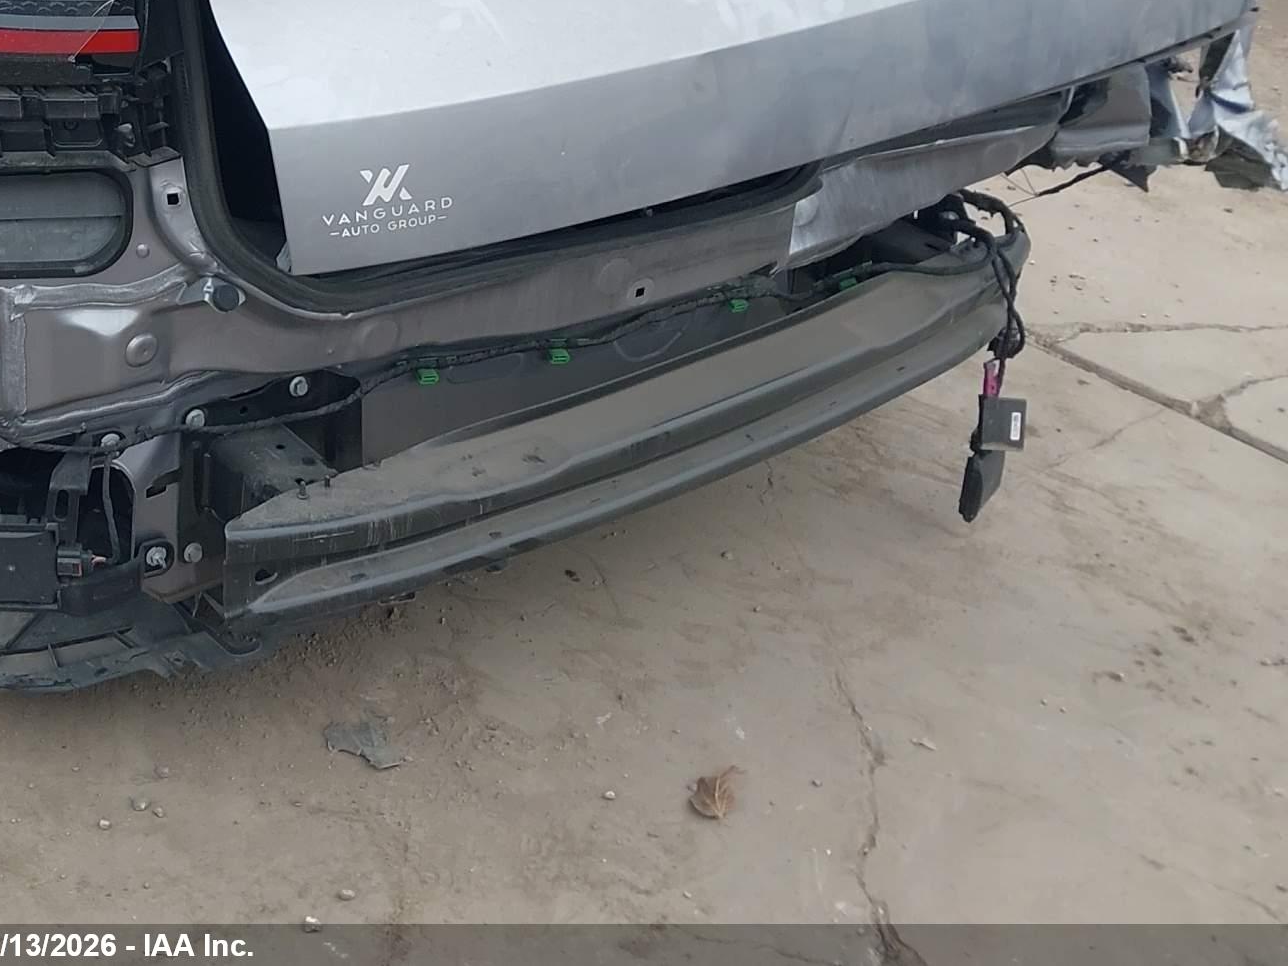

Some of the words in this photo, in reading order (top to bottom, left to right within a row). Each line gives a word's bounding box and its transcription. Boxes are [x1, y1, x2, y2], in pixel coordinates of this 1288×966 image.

[322, 197, 453, 226] VANGUARD
[341, 223, 380, 238] AUTO
[387, 214, 436, 231] GROUP
